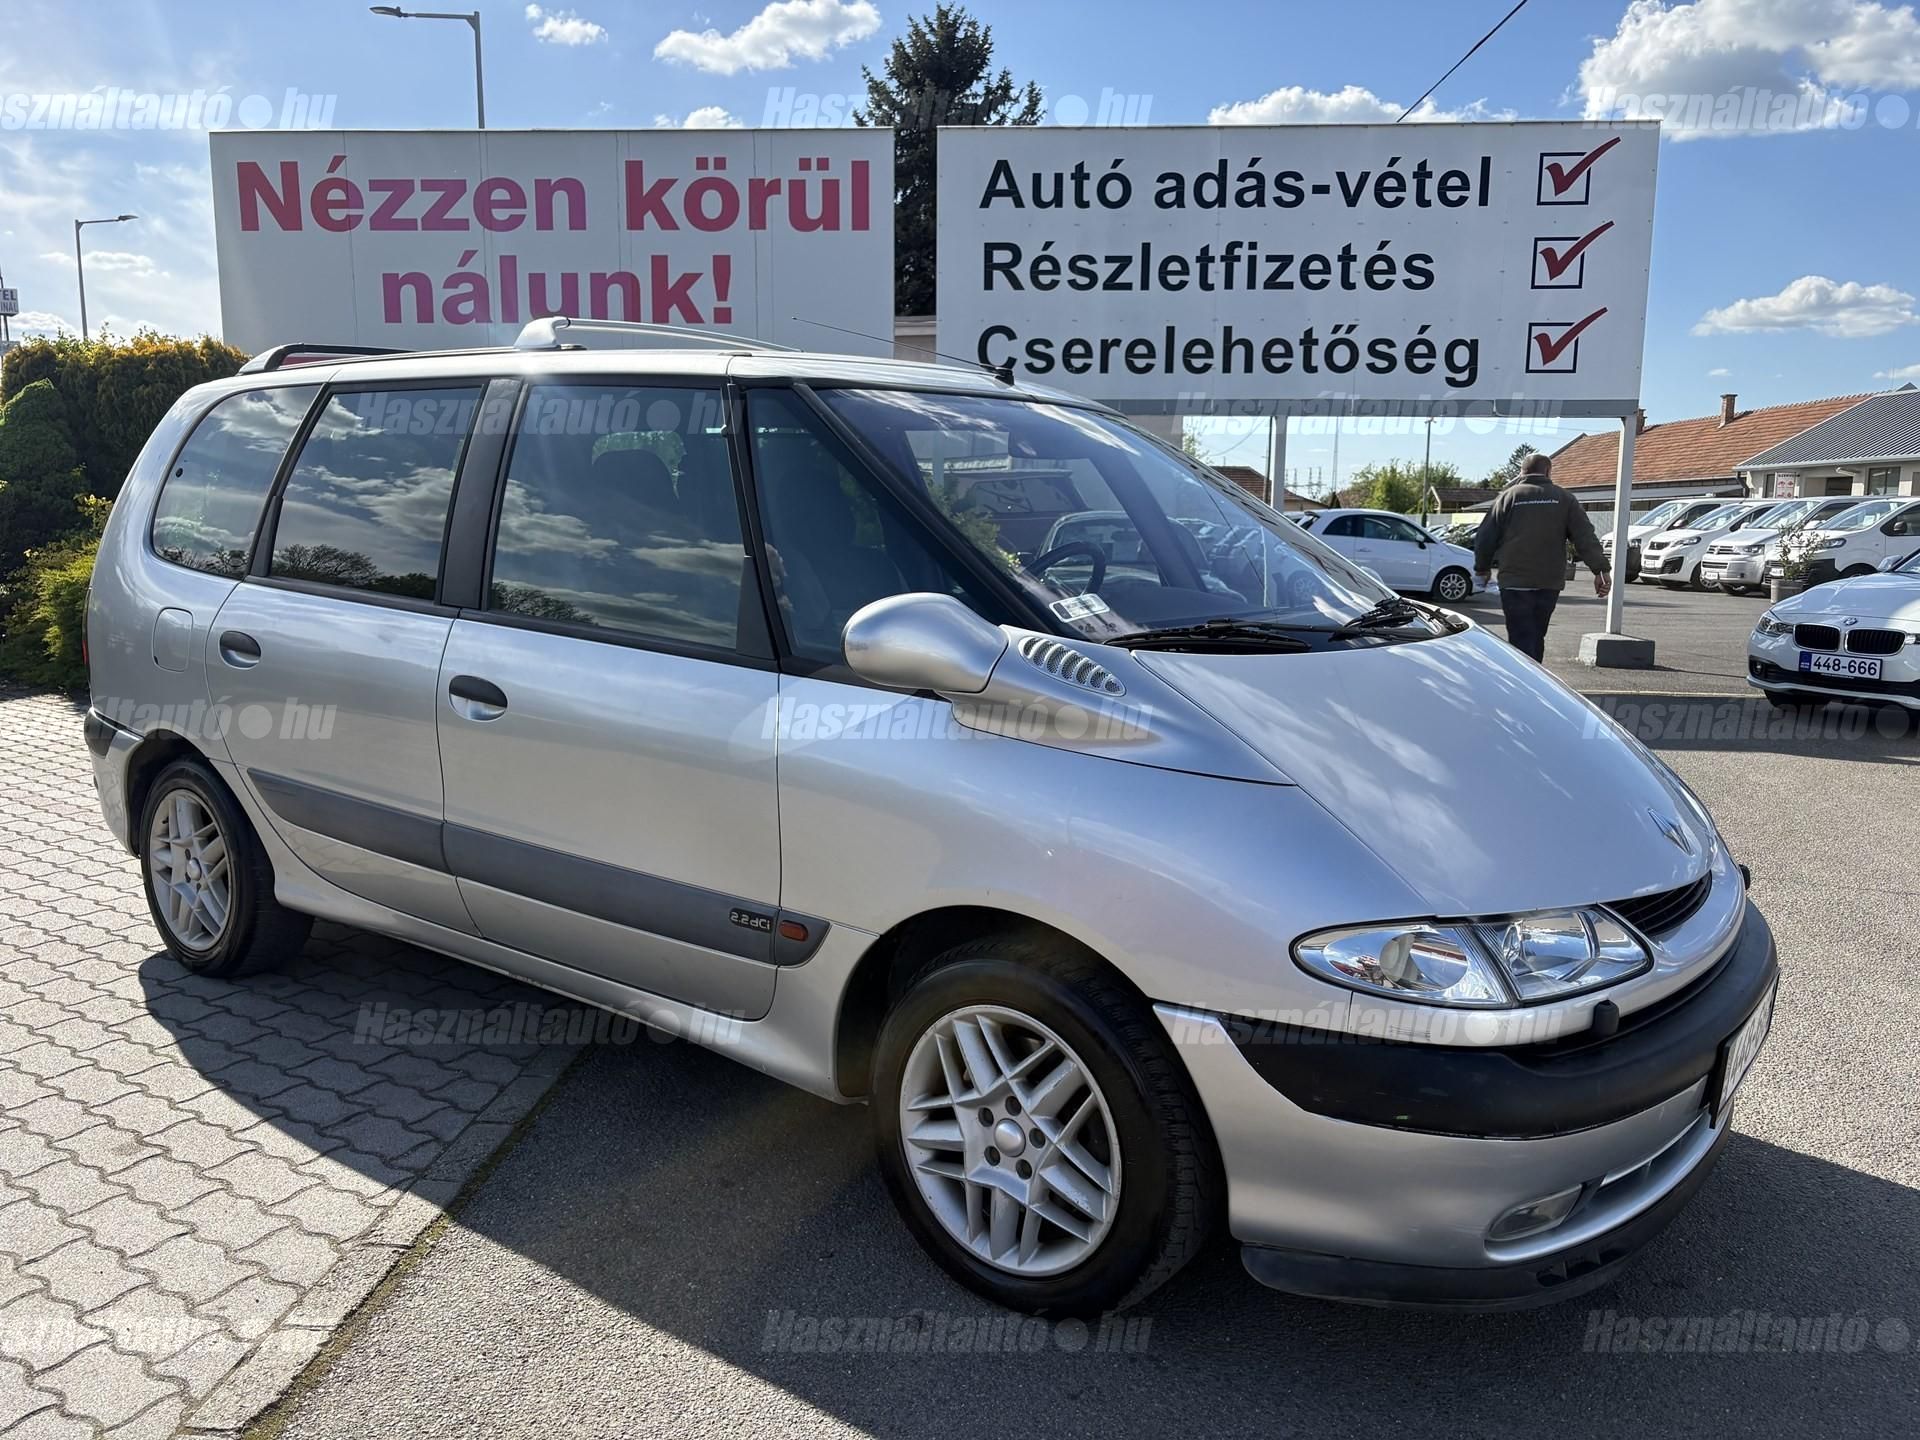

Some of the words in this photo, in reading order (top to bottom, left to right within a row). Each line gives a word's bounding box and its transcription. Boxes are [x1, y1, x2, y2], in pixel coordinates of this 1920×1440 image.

[236, 155, 586, 232] Nézzen
[624, 157, 869, 232] körül
[979, 159, 1132, 209] Autó
[1154, 156, 1491, 209] adás-vétel
[382, 250, 732, 325] nálunk!
[983, 240, 1435, 291] Részletfizetés
[977, 324, 1479, 388] Cserelehetőség
[1813, 656, 1877, 676] 448-666
